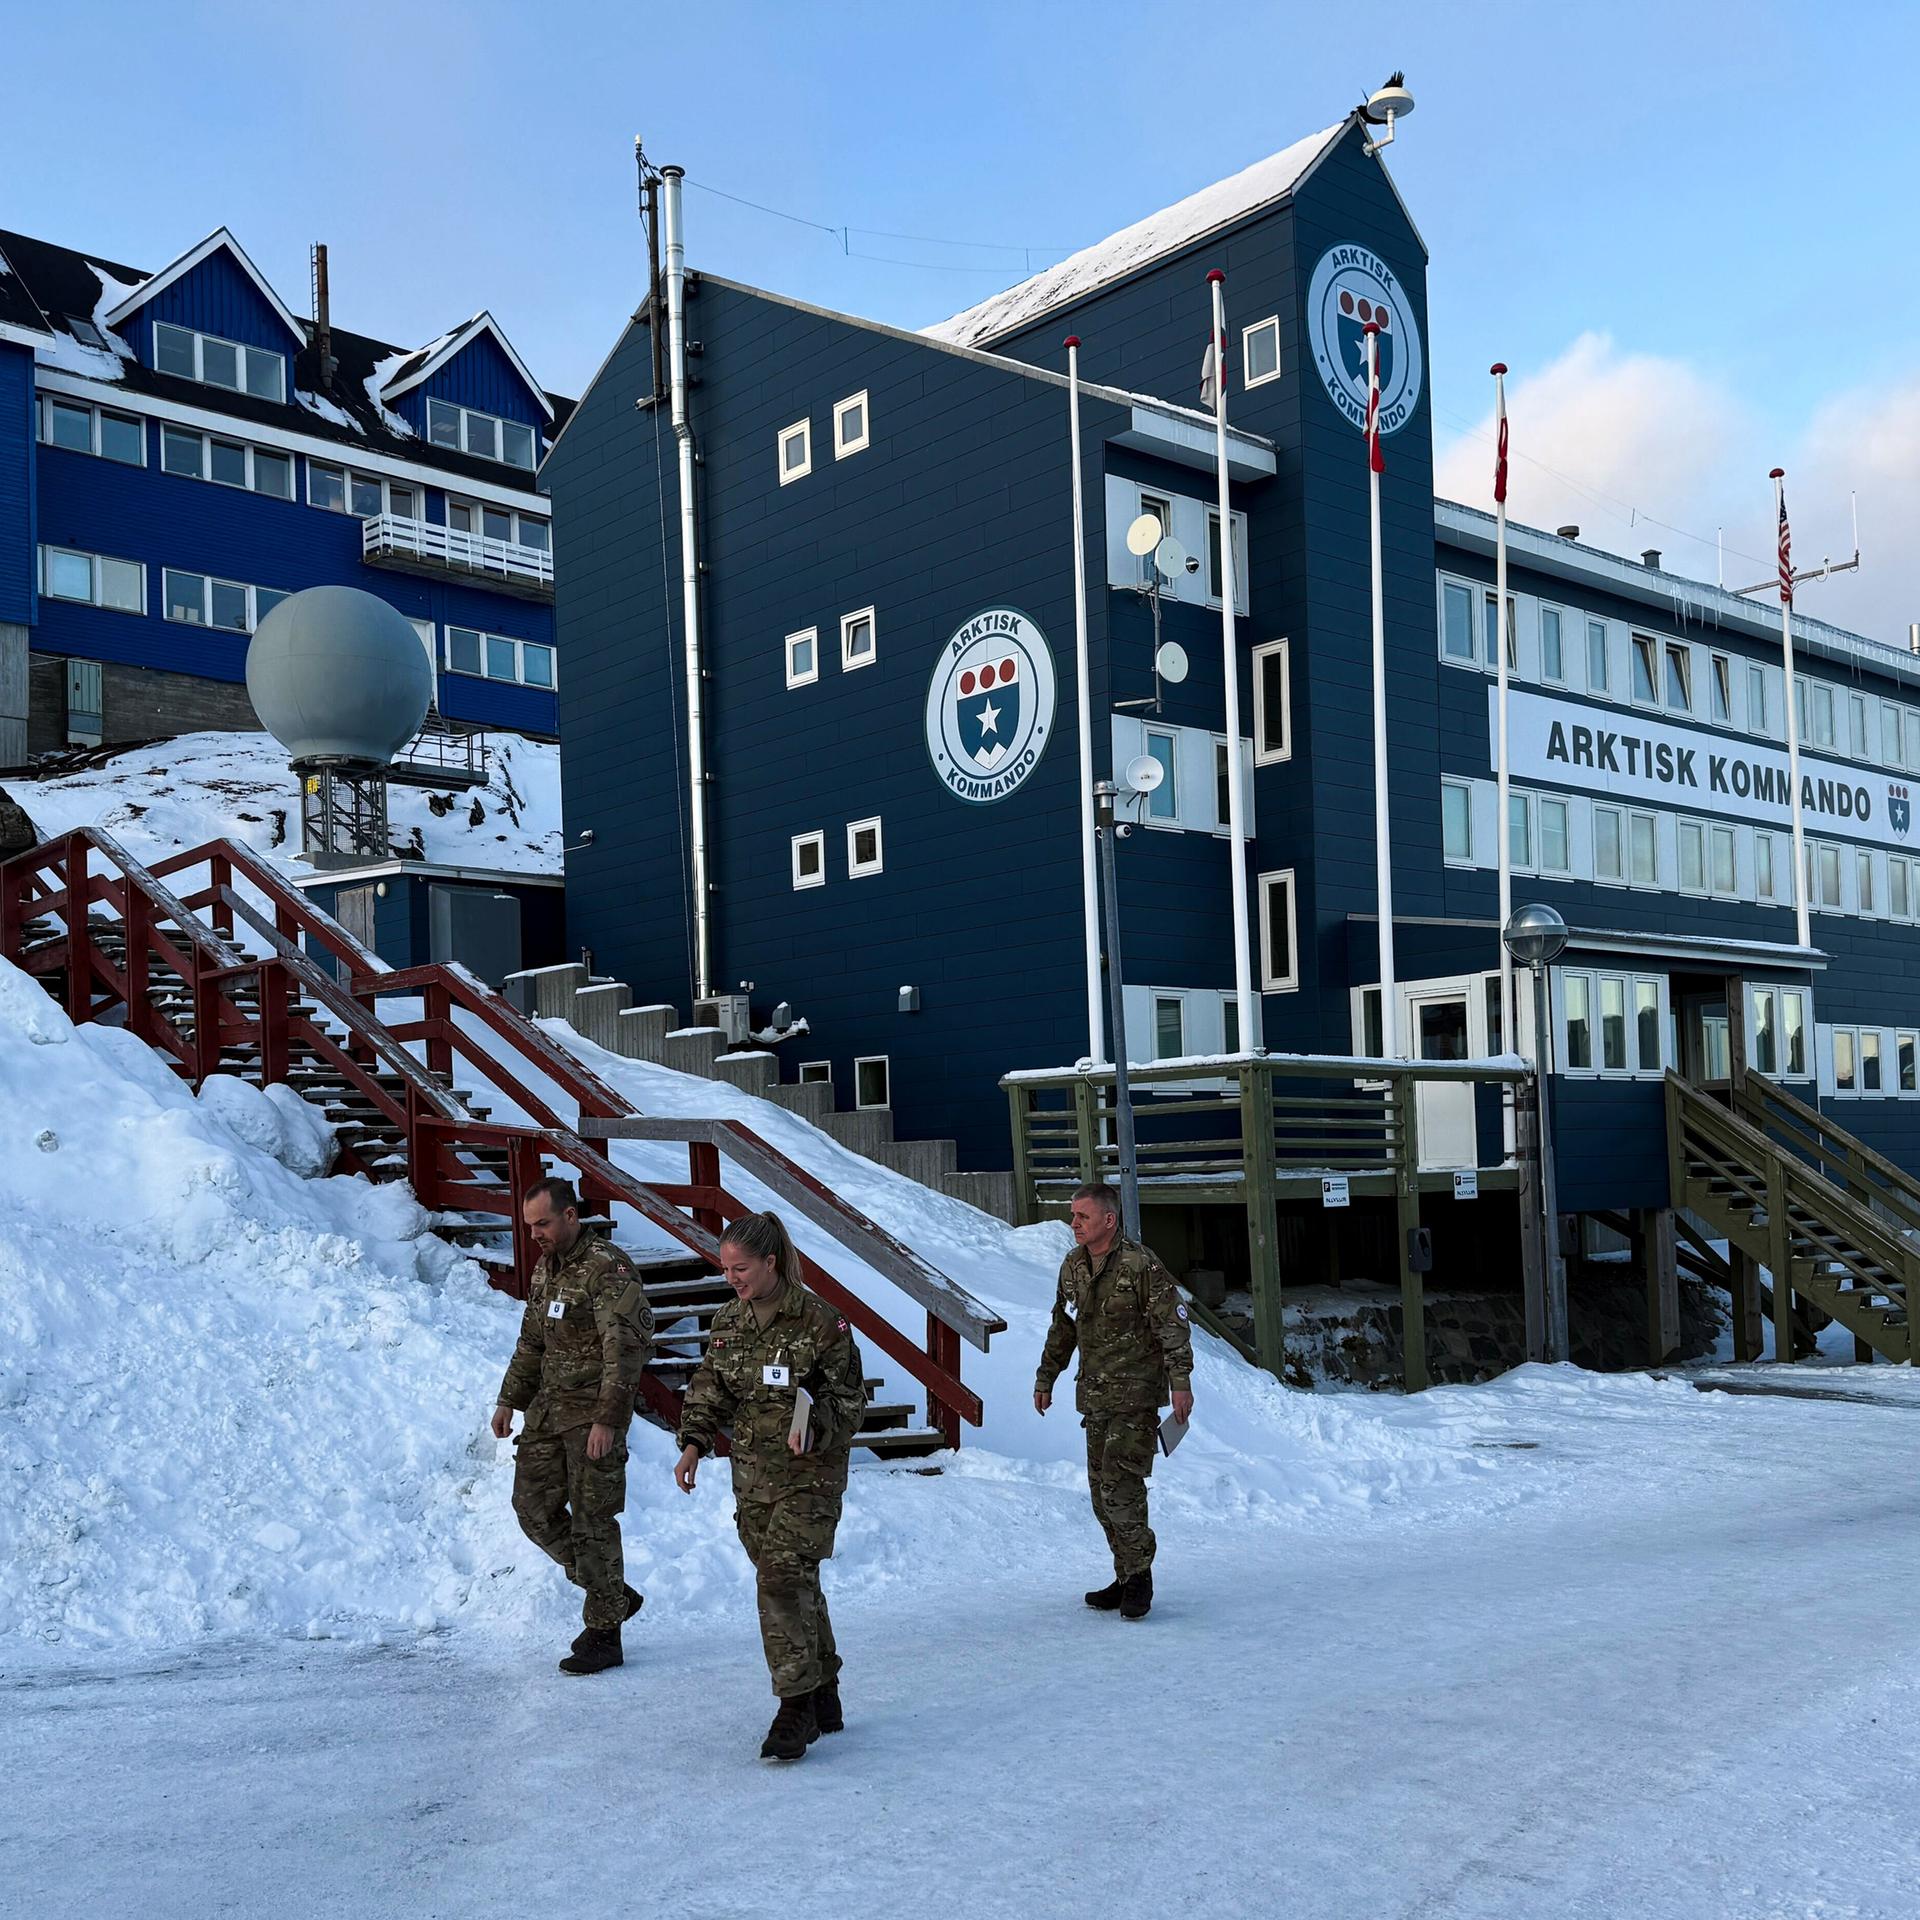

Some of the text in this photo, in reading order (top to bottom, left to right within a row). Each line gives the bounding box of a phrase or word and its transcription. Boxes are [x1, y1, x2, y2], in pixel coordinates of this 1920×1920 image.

[1332, 248, 1394, 291] ARKTISK
[1327, 377, 1406, 431] KOMNDO
[951, 614, 1022, 658] ARKTISK
[946, 749, 1035, 798] KOMMANDO
[1546, 720, 1698, 788] ARKTISK
